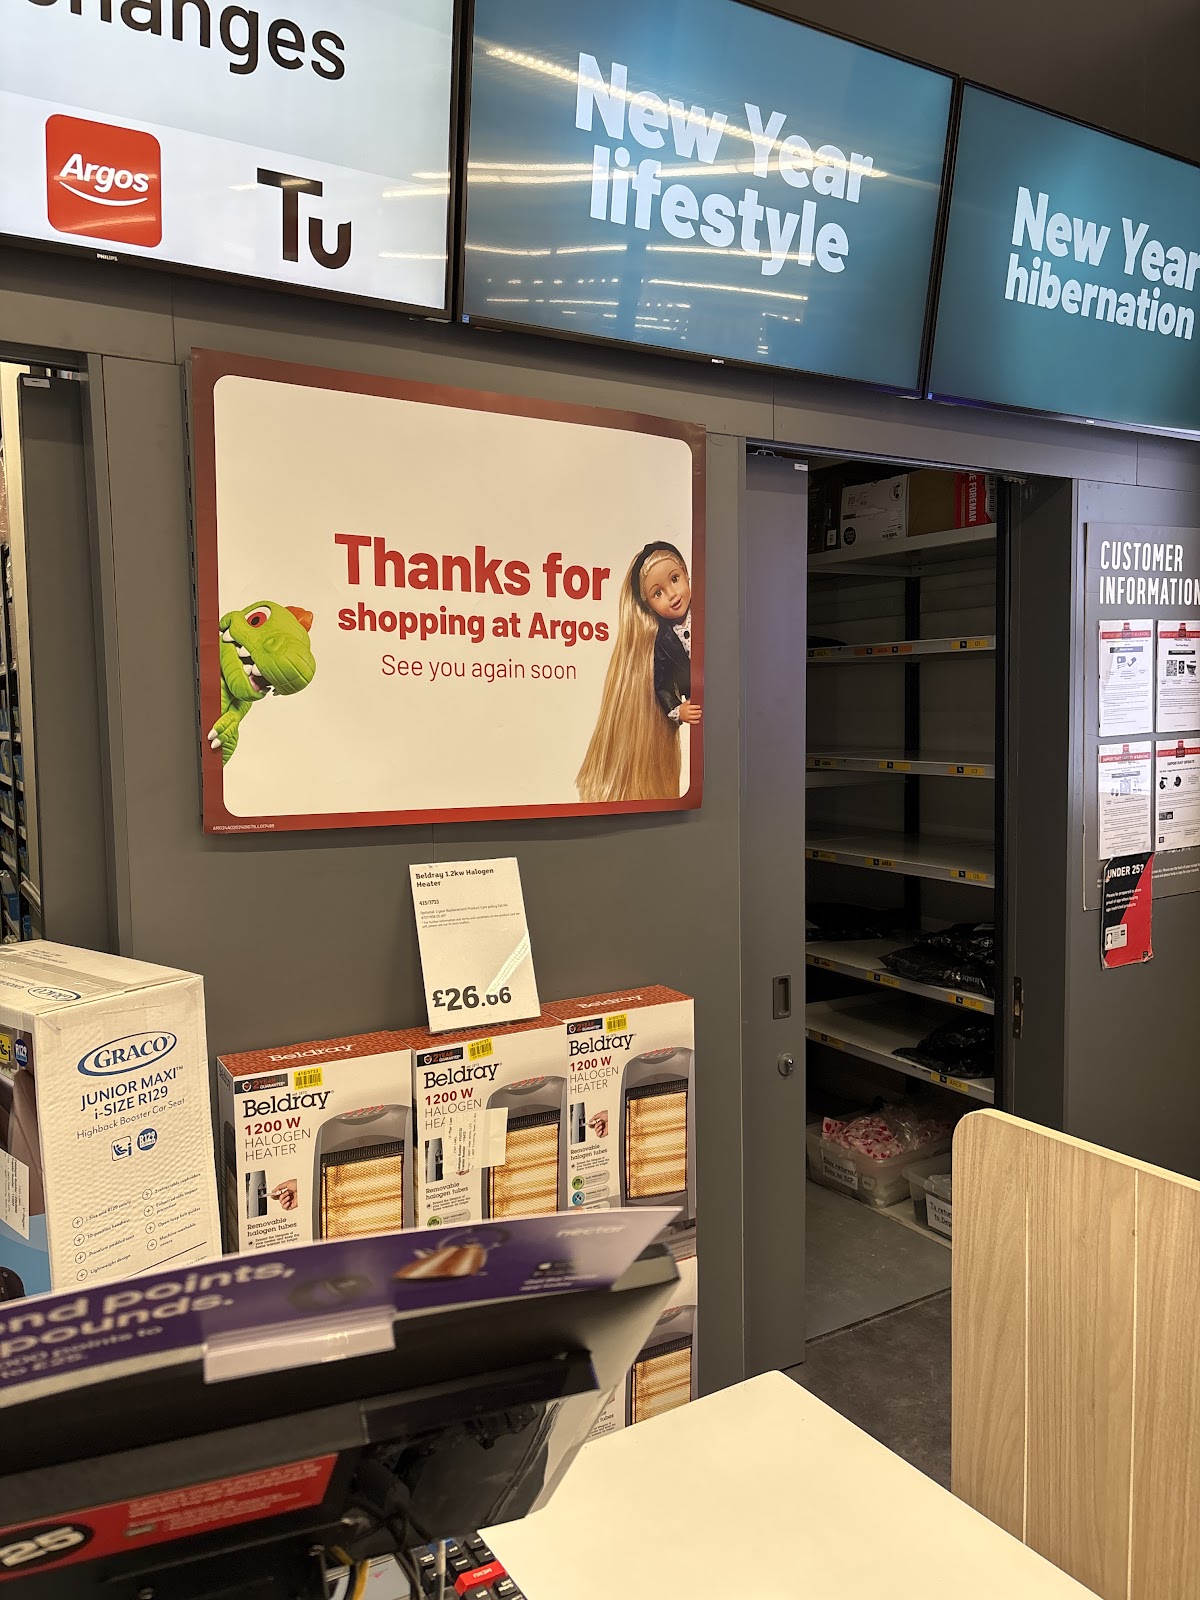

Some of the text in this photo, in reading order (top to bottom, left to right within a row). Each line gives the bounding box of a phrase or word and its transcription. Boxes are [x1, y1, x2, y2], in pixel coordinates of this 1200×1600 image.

[25, 0, 345, 80] anges
[575, 52, 875, 203] New Year
[59, 153, 149, 193] Argos
[257, 168, 351, 269] Tu
[589, 144, 850, 275] lifestyle
[1012, 186, 1200, 292] New Year
[96, 253, 118, 262] PHILIPS
[1005, 258, 1195, 339] hibernation
[969, 482, 977, 522] FOREMAN
[335, 533, 610, 600] Thanks for
[1101, 541, 1183, 572] CUSTOMER
[1100, 576, 1200, 606] INFORMATION
[338, 602, 610, 647] shopping at Argos
[381, 655, 577, 682] See you again soon
[415, 868, 494, 880] Beldray 1.2kw Halogen
[1108, 866, 1131, 879] UNDER
[1132, 864, 1145, 875] 25?
[416, 880, 442, 888] Heater
[432, 985, 512, 1012] £26.66
[578, 995, 644, 1010] Beldray
[577, 1024, 582, 1032] 2
[94, 1036, 168, 1069] GRACO
[268, 1043, 356, 1063] Beldray
[569, 1034, 634, 1057] Beldray
[432, 1054, 439, 1062] 2
[570, 1056, 612, 1072] 1200 W
[253, 1080, 259, 1090] 2
[424, 1062, 500, 1090] Beldray
[570, 1066, 620, 1084] HALOGEN
[81, 1081, 138, 1112] JUNIOR
[425, 1088, 474, 1106] 1200 W
[570, 1080, 609, 1095] HEATER
[95, 1086, 169, 1120] i-SIZE R129
[242, 1091, 331, 1118] Beldray
[425, 1098, 483, 1119] HALOGEN
[76, 1098, 186, 1140] Highback Booster Car Seat
[245, 1116, 302, 1136] 1200 W
[245, 1128, 312, 1150] HALOGEN
[571, 1144, 601, 1155] Removable
[245, 1144, 297, 1162] HEATER
[571, 1152, 592, 1161] halogen
[426, 1182, 460, 1194] Removable
[426, 1187, 469, 1201] halogen tubes
[247, 1218, 287, 1230] Removable
[247, 1222, 297, 1237] halogen tubes
[102, 1262, 296, 1315] points,
[0, 1294, 234, 1358] pounds.
